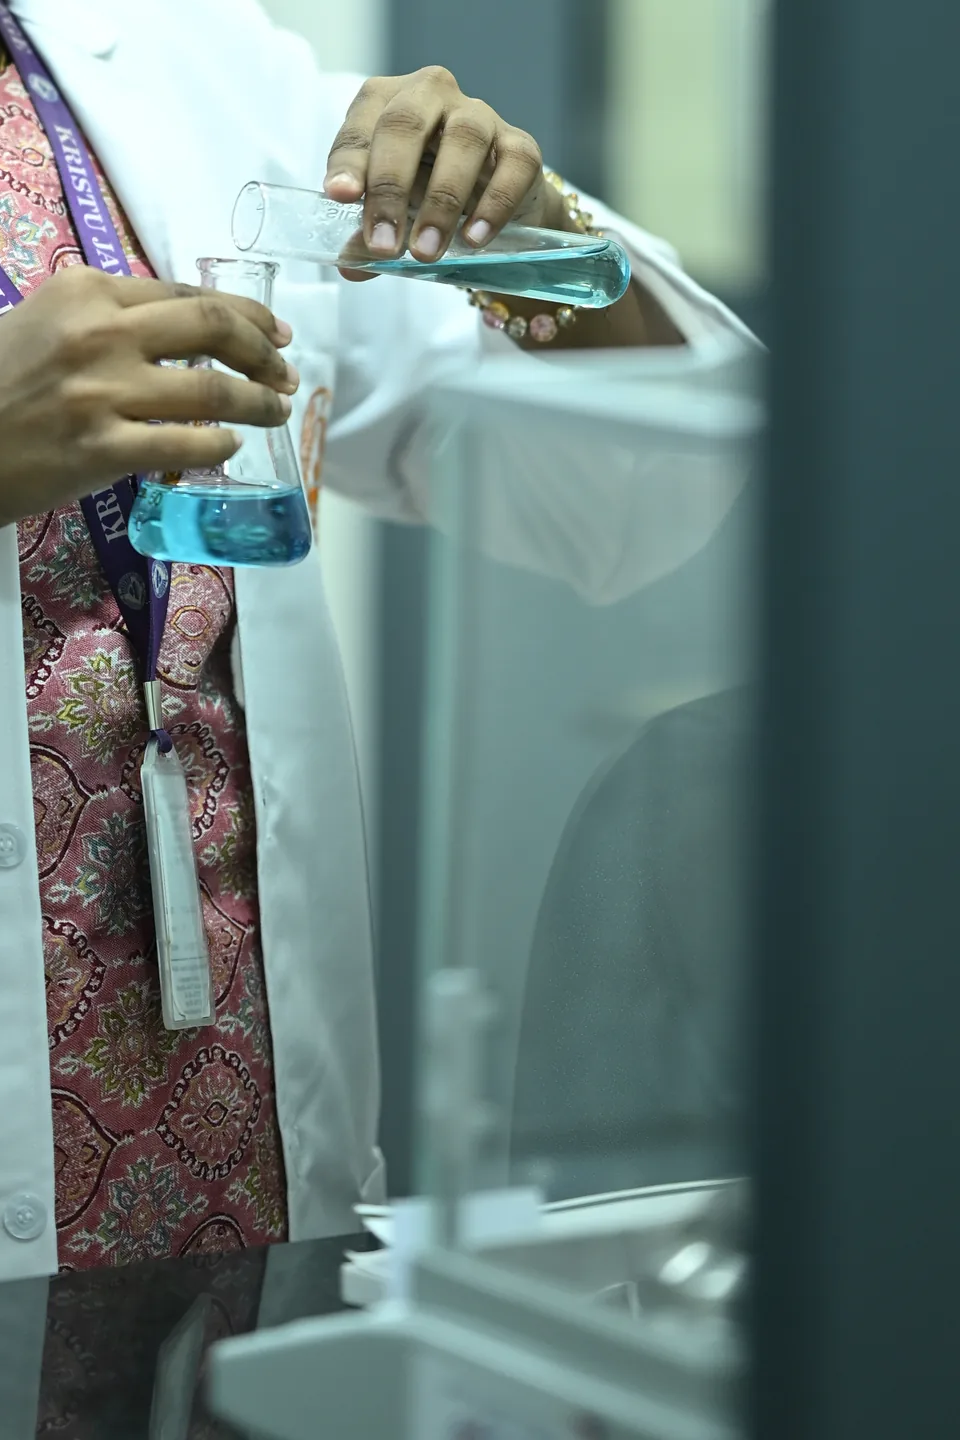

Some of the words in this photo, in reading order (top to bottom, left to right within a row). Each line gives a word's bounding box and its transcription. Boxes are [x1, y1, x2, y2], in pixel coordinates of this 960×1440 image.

[53, 124, 107, 234] KRISTU
[92, 236, 124, 277] JA
[90, 485, 128, 544] KRI
